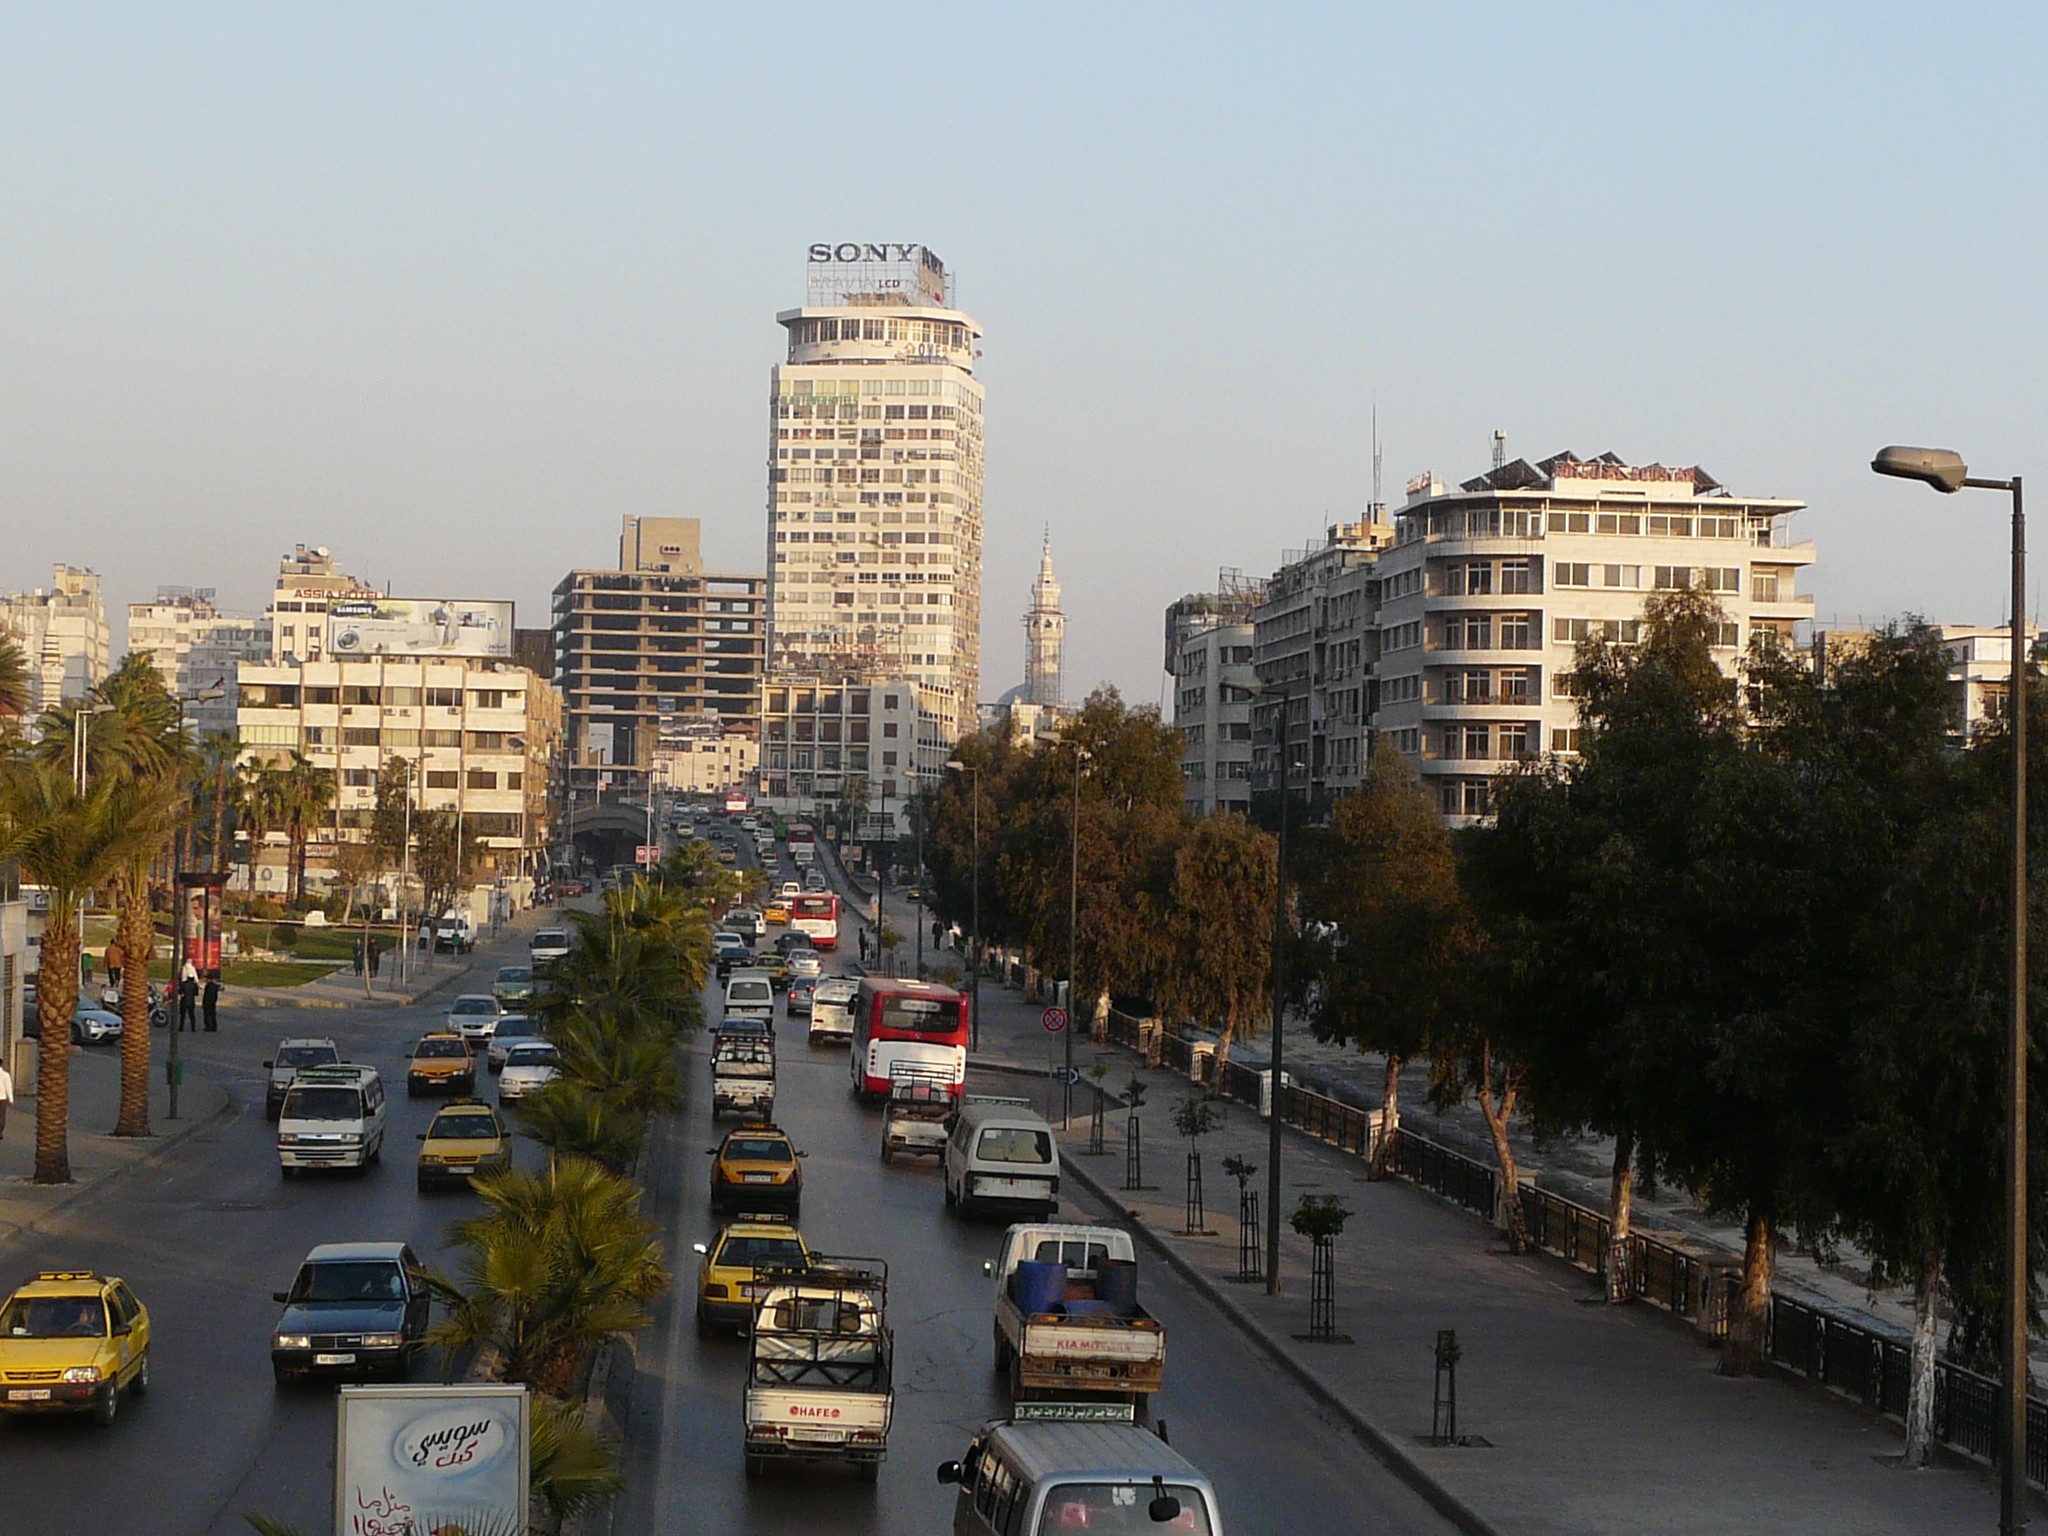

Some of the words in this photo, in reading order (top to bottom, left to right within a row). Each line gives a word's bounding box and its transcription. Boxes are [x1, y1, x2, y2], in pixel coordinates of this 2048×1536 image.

[809, 243, 918, 262] SONY
[809, 276, 874, 289] BRAVIA
[878, 279, 900, 289] LCD
[294, 589, 334, 599] ASSIA
[338, 590, 385, 600] HOTEL
[336, 606, 372, 614] SAMSUNG
[1057, 1340, 1078, 1349] KIA
[412, 1420, 491, 1466] سويسي
[356, 1486, 382, 1509] ما
[376, 1486, 411, 1518] مثل
